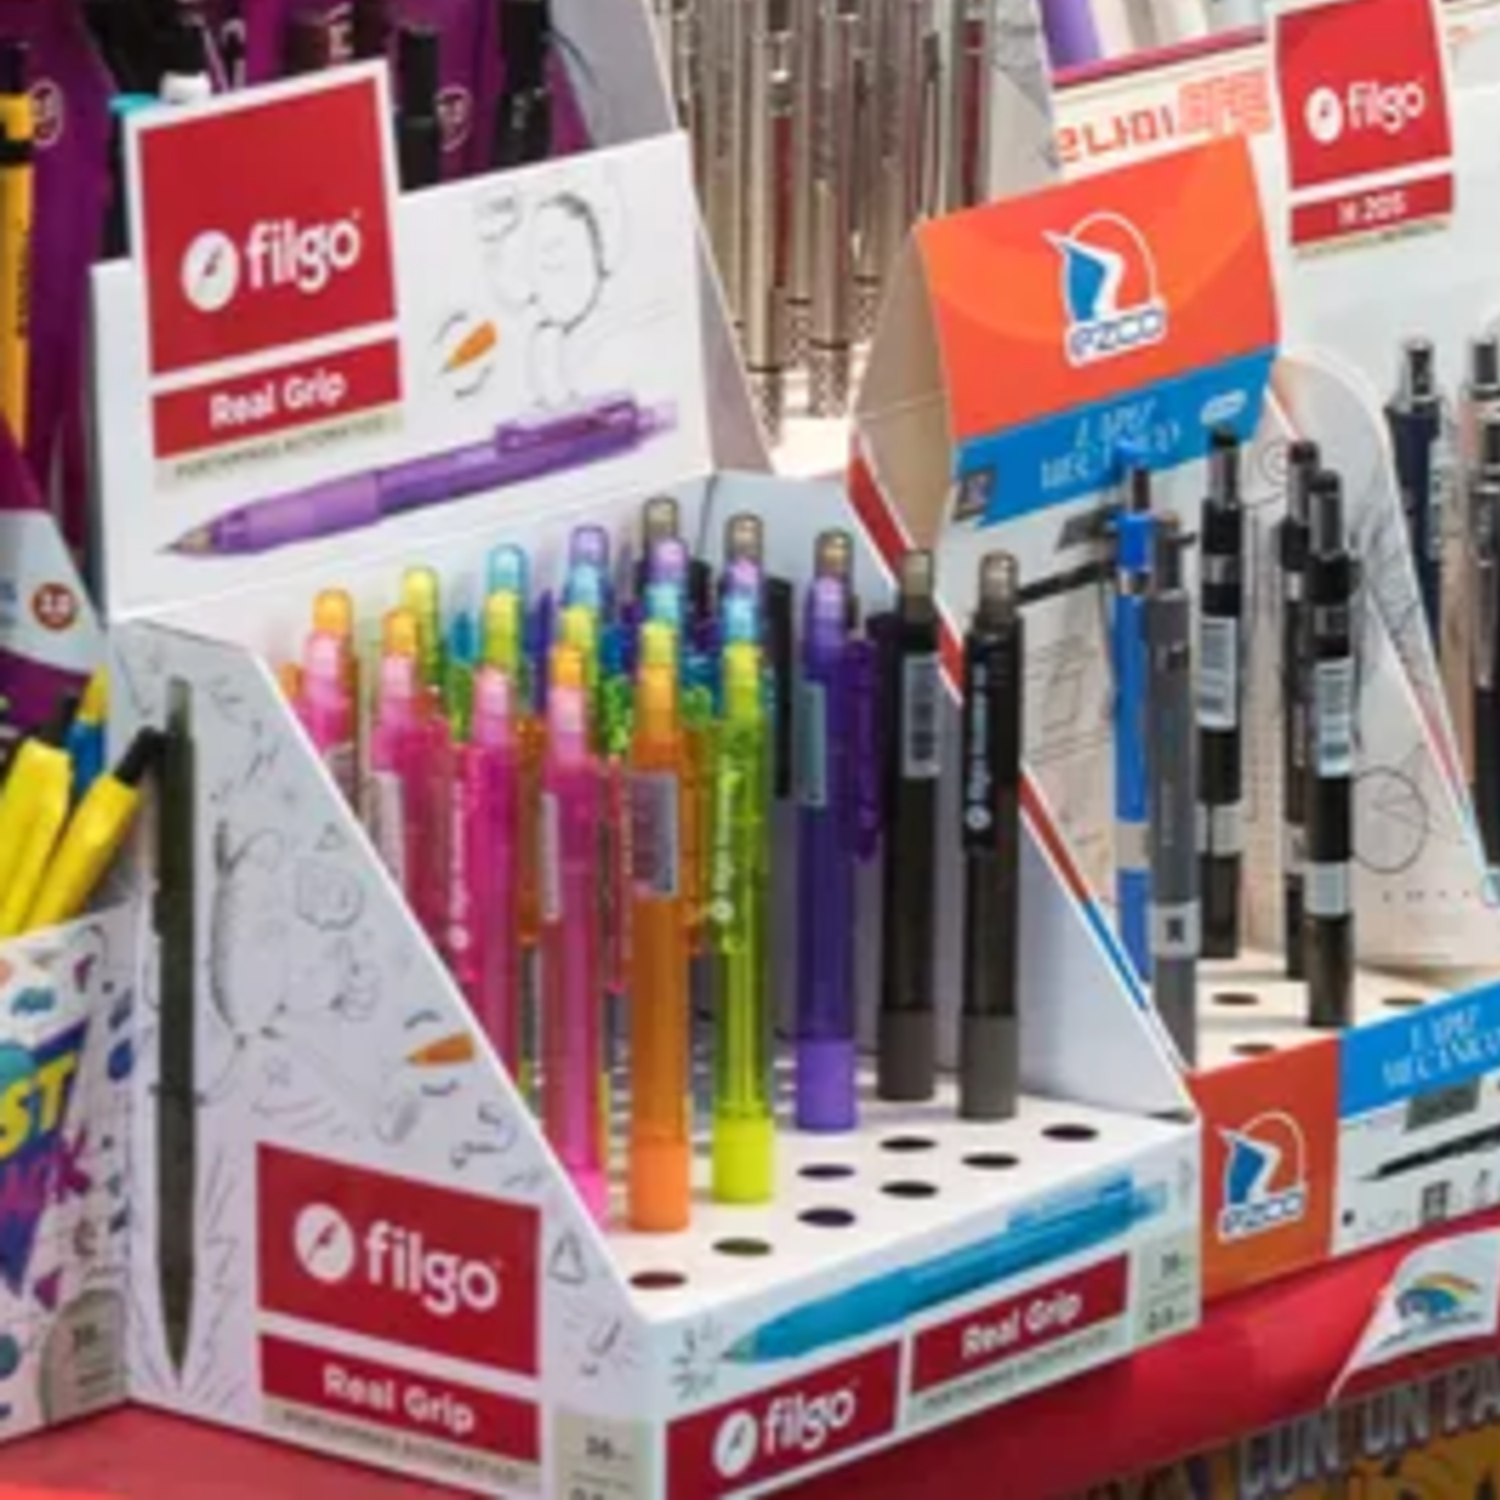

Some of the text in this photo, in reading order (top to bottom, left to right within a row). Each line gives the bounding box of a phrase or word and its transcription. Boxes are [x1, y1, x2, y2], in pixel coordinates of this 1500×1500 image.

[1346, 80, 1424, 135] filgo
[245, 217, 361, 294] filgo
[209, 368, 347, 431] Real Grip
[365, 1220, 499, 1318] filgo
[961, 1290, 1083, 1359] Real Grip
[323, 1364, 476, 1434] Real Grip
[762, 1385, 856, 1457] filgo
